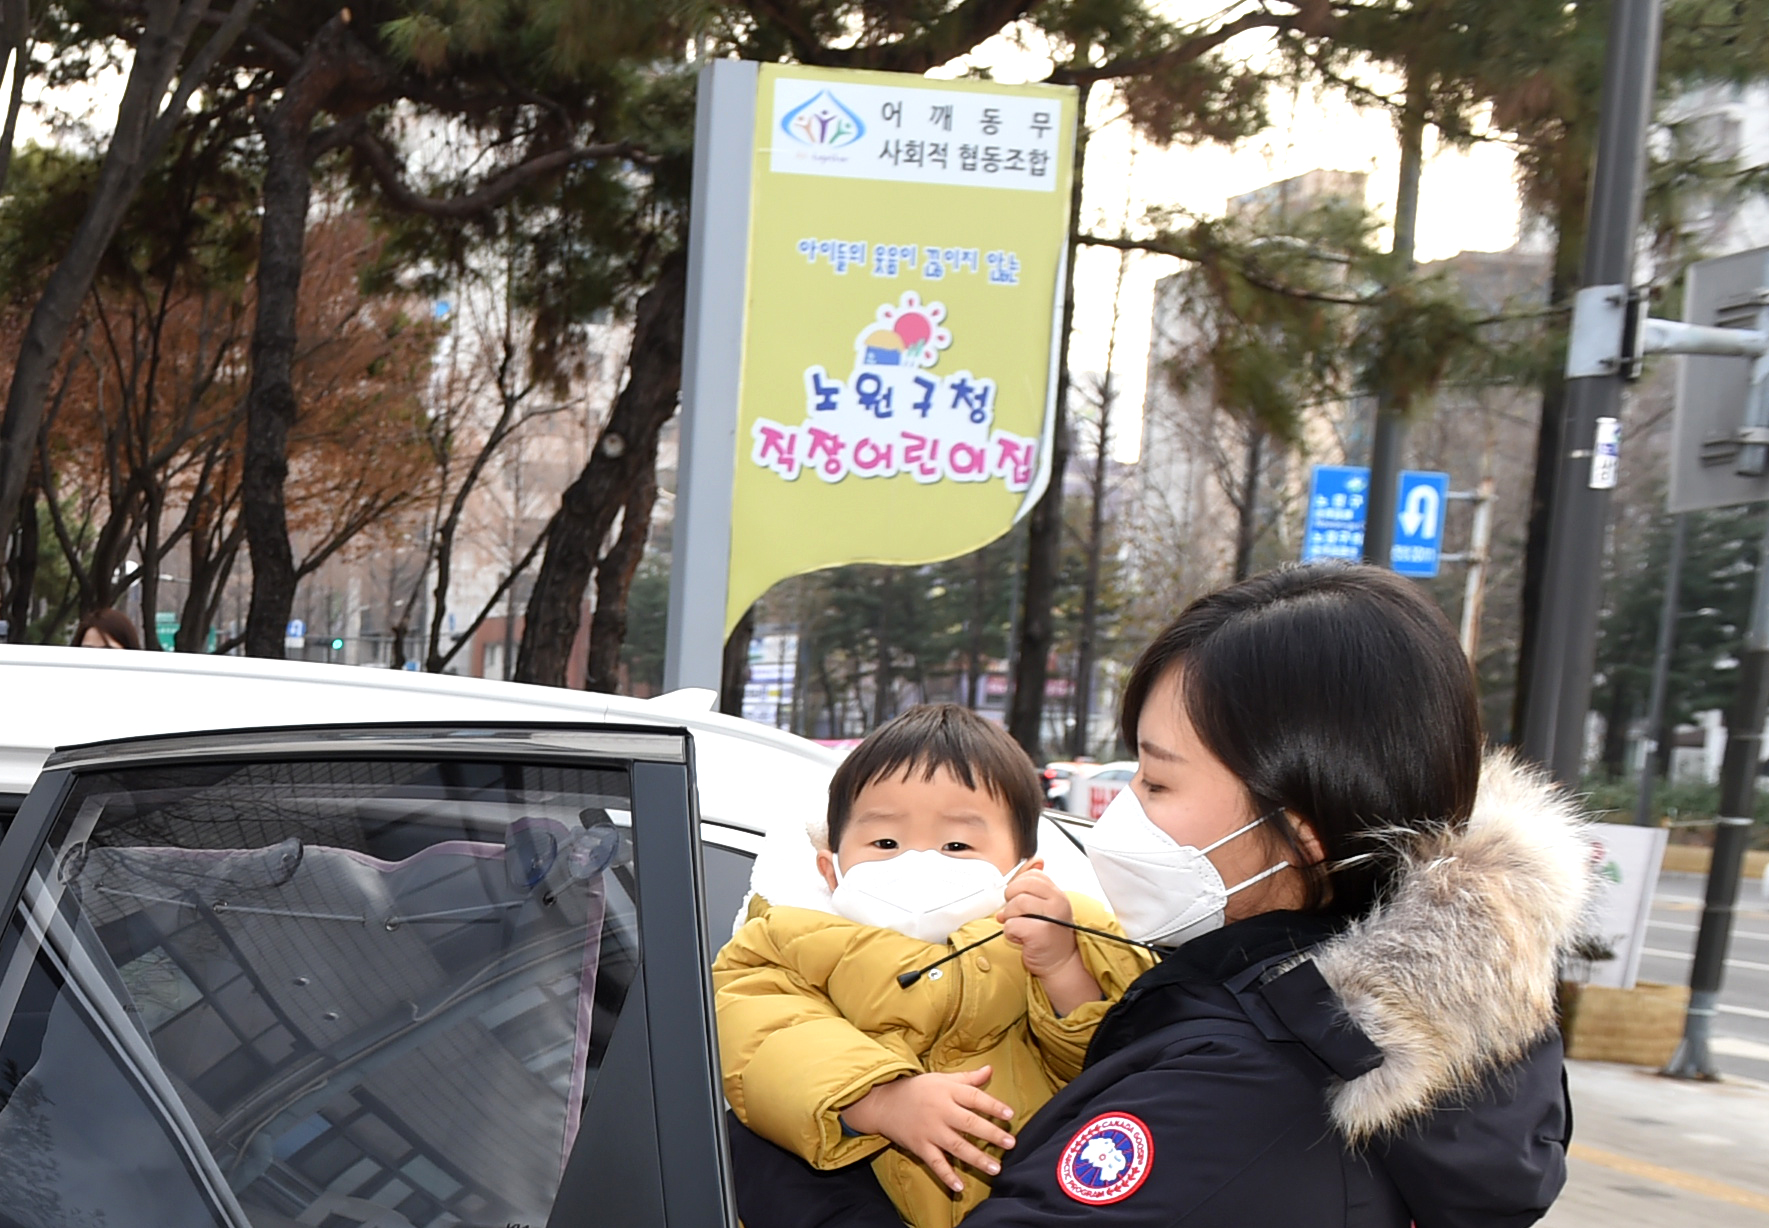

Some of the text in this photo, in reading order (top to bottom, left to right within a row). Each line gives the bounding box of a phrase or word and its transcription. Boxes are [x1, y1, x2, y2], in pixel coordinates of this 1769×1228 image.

[879, 139, 1050, 177] 사회적 협동조합
[799, 239, 1019, 283] 아이들의 웃음이 끊이지 않는
[759, 426, 1035, 485] 직장어린이집
[1101, 1120, 1134, 1134] CANADA
[1063, 1153, 1105, 1198] ARCTIC PROGRAM
